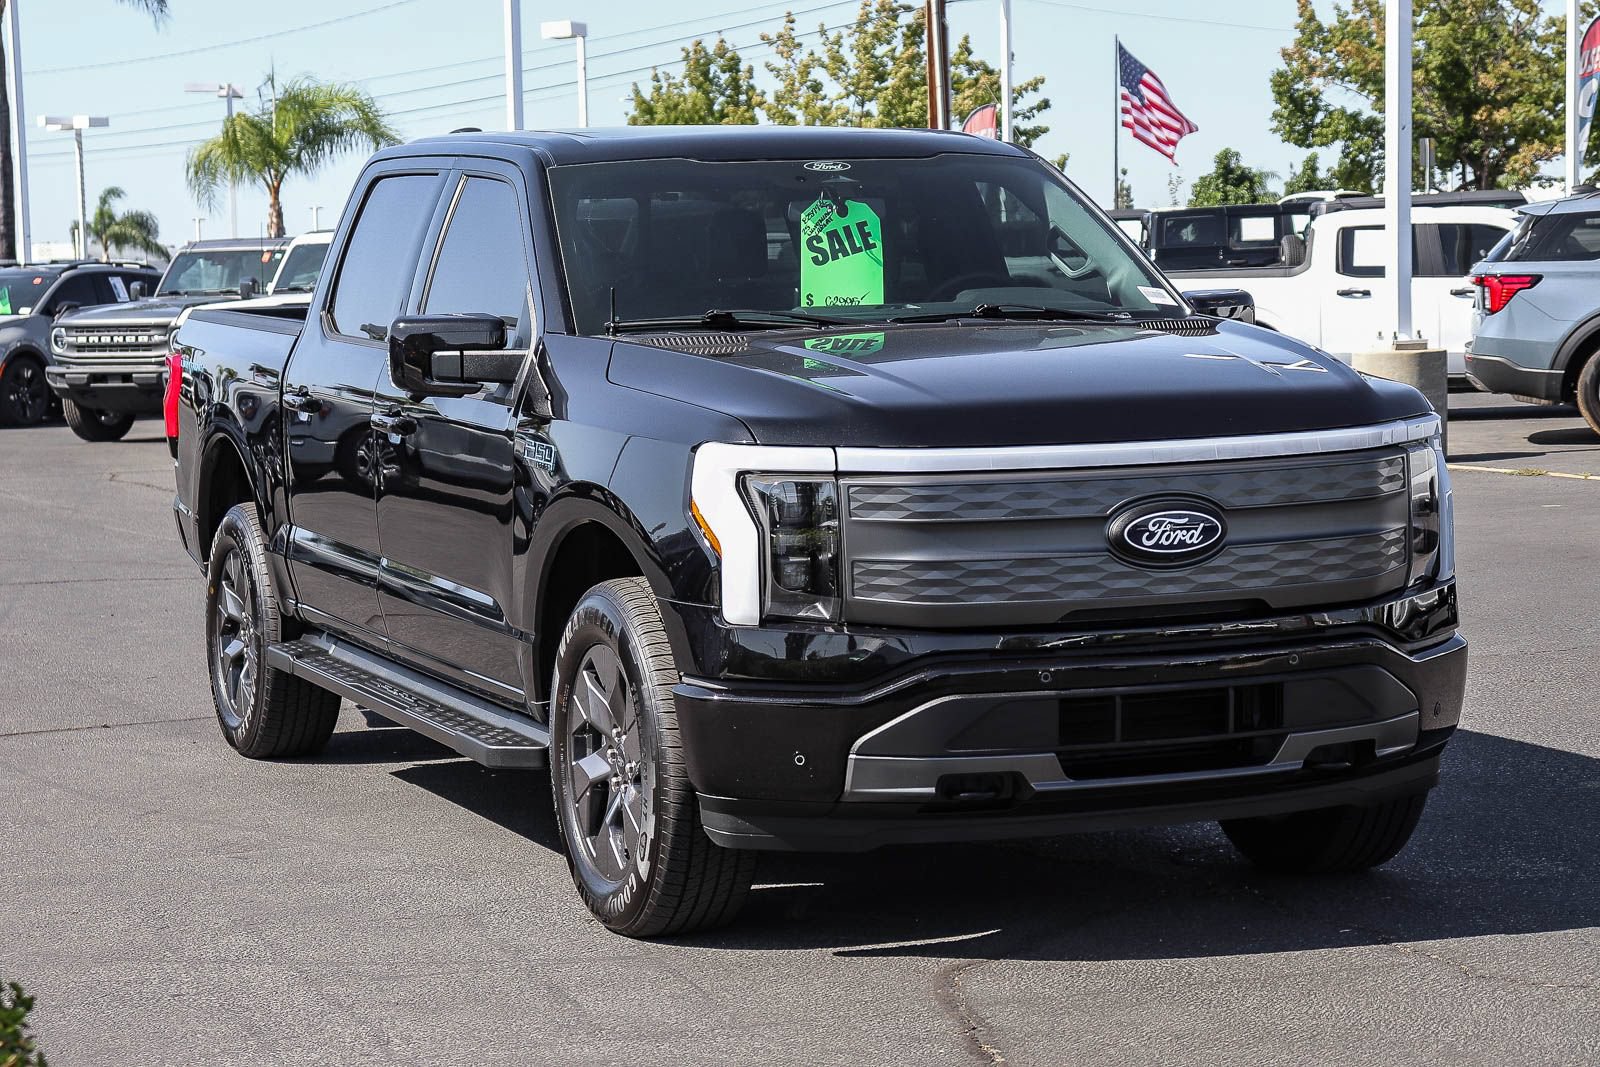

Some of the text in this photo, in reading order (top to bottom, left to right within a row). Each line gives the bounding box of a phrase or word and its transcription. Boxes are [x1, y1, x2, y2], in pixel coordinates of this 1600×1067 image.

[805, 220, 877, 266] SALE
[806, 293, 814, 307] $
[1141, 517, 1204, 546] Ford
